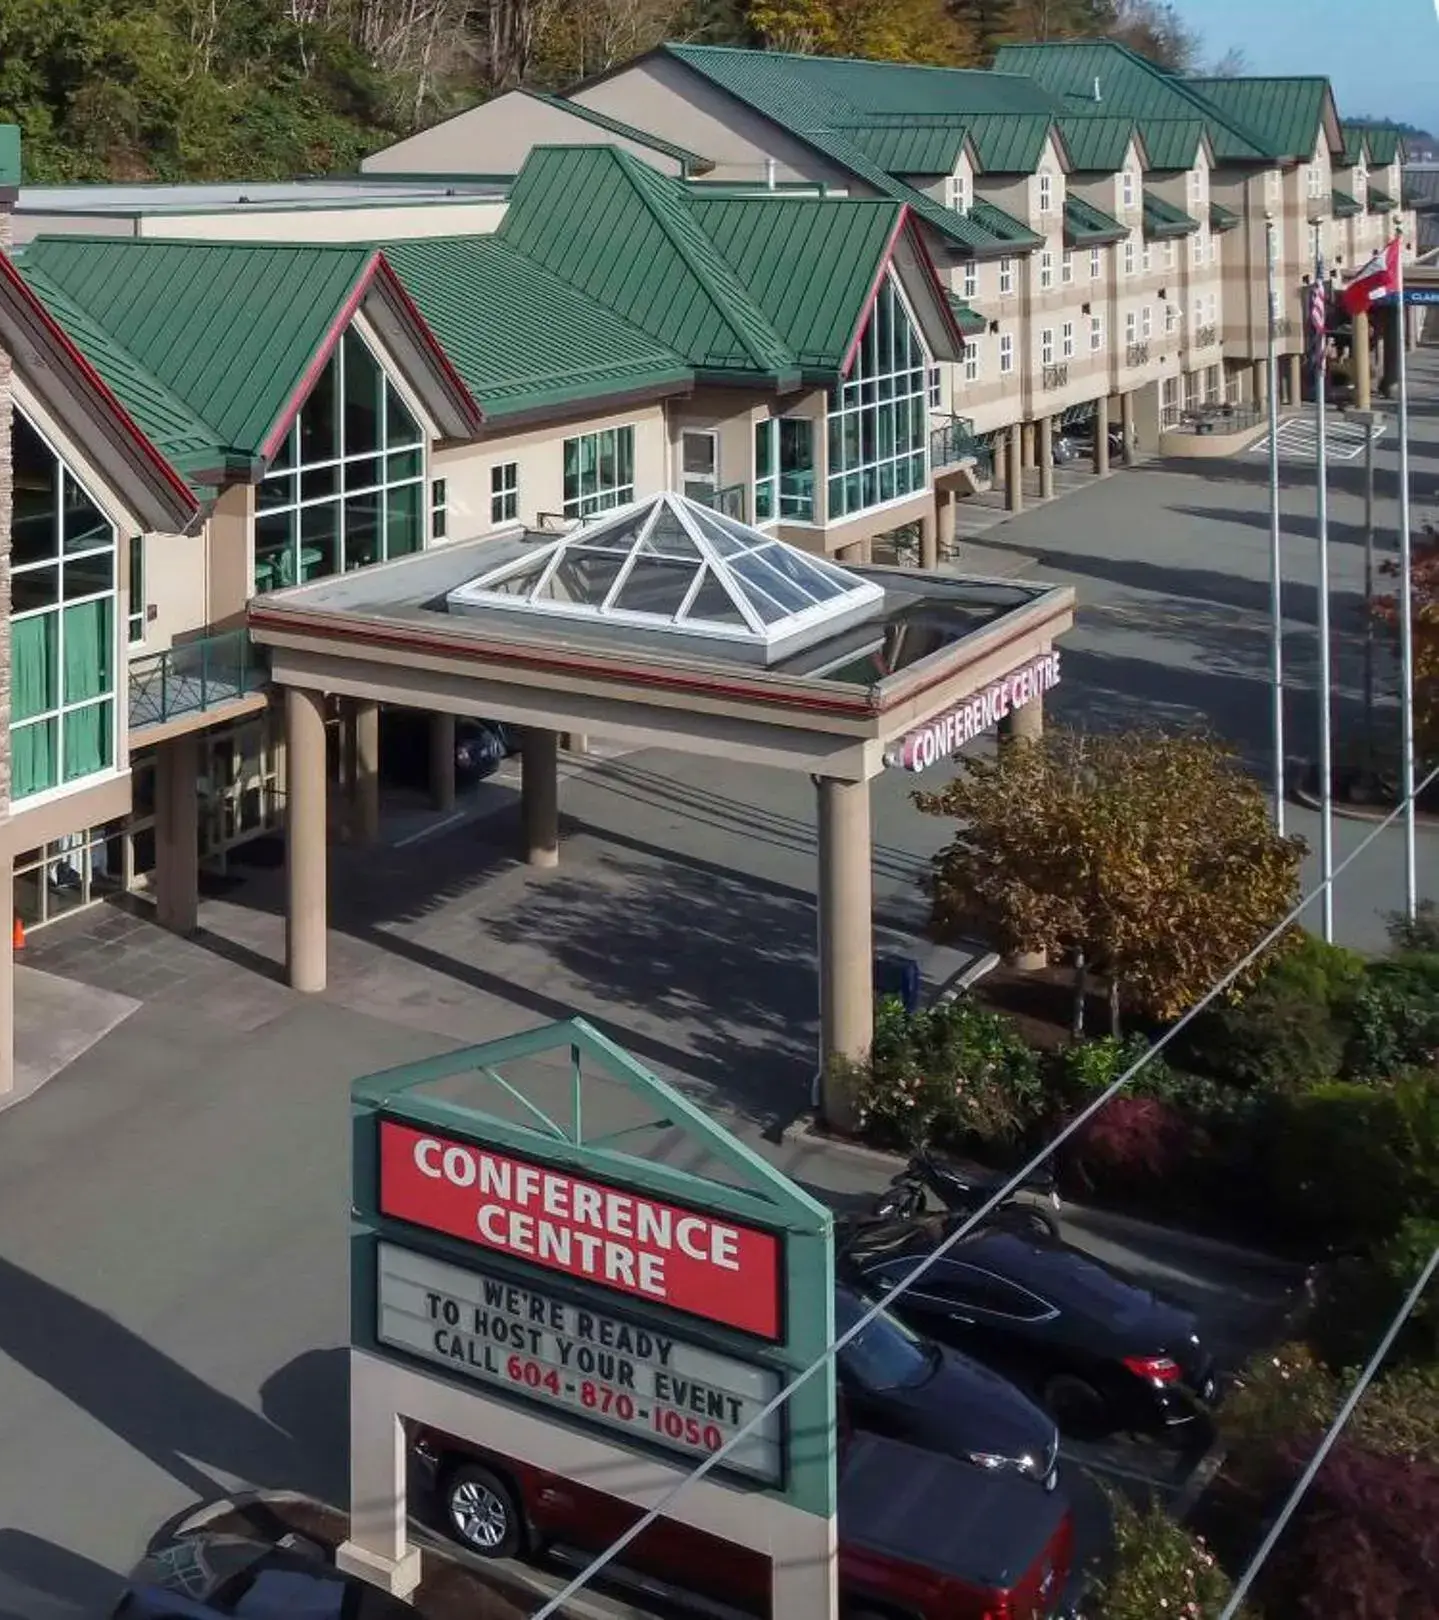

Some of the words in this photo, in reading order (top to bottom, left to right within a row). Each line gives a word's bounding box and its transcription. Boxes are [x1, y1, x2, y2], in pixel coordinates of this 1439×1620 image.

[913, 683, 1009, 772] CONFERENCE
[1012, 651, 1060, 708] CENTRE
[413, 1139, 740, 1271] CONFERENCE
[477, 1205, 667, 1297] CENTRE
[426, 1292, 459, 1325] TO
[474, 1309, 542, 1354] HOST
[555, 1337, 634, 1389] YOUR
[654, 1371, 743, 1425] EVENT
[483, 1280, 563, 1330] WE'RE
[577, 1312, 673, 1366] READY
[434, 1330, 499, 1373] CALL
[506, 1355, 722, 1451] 604-870-1050
